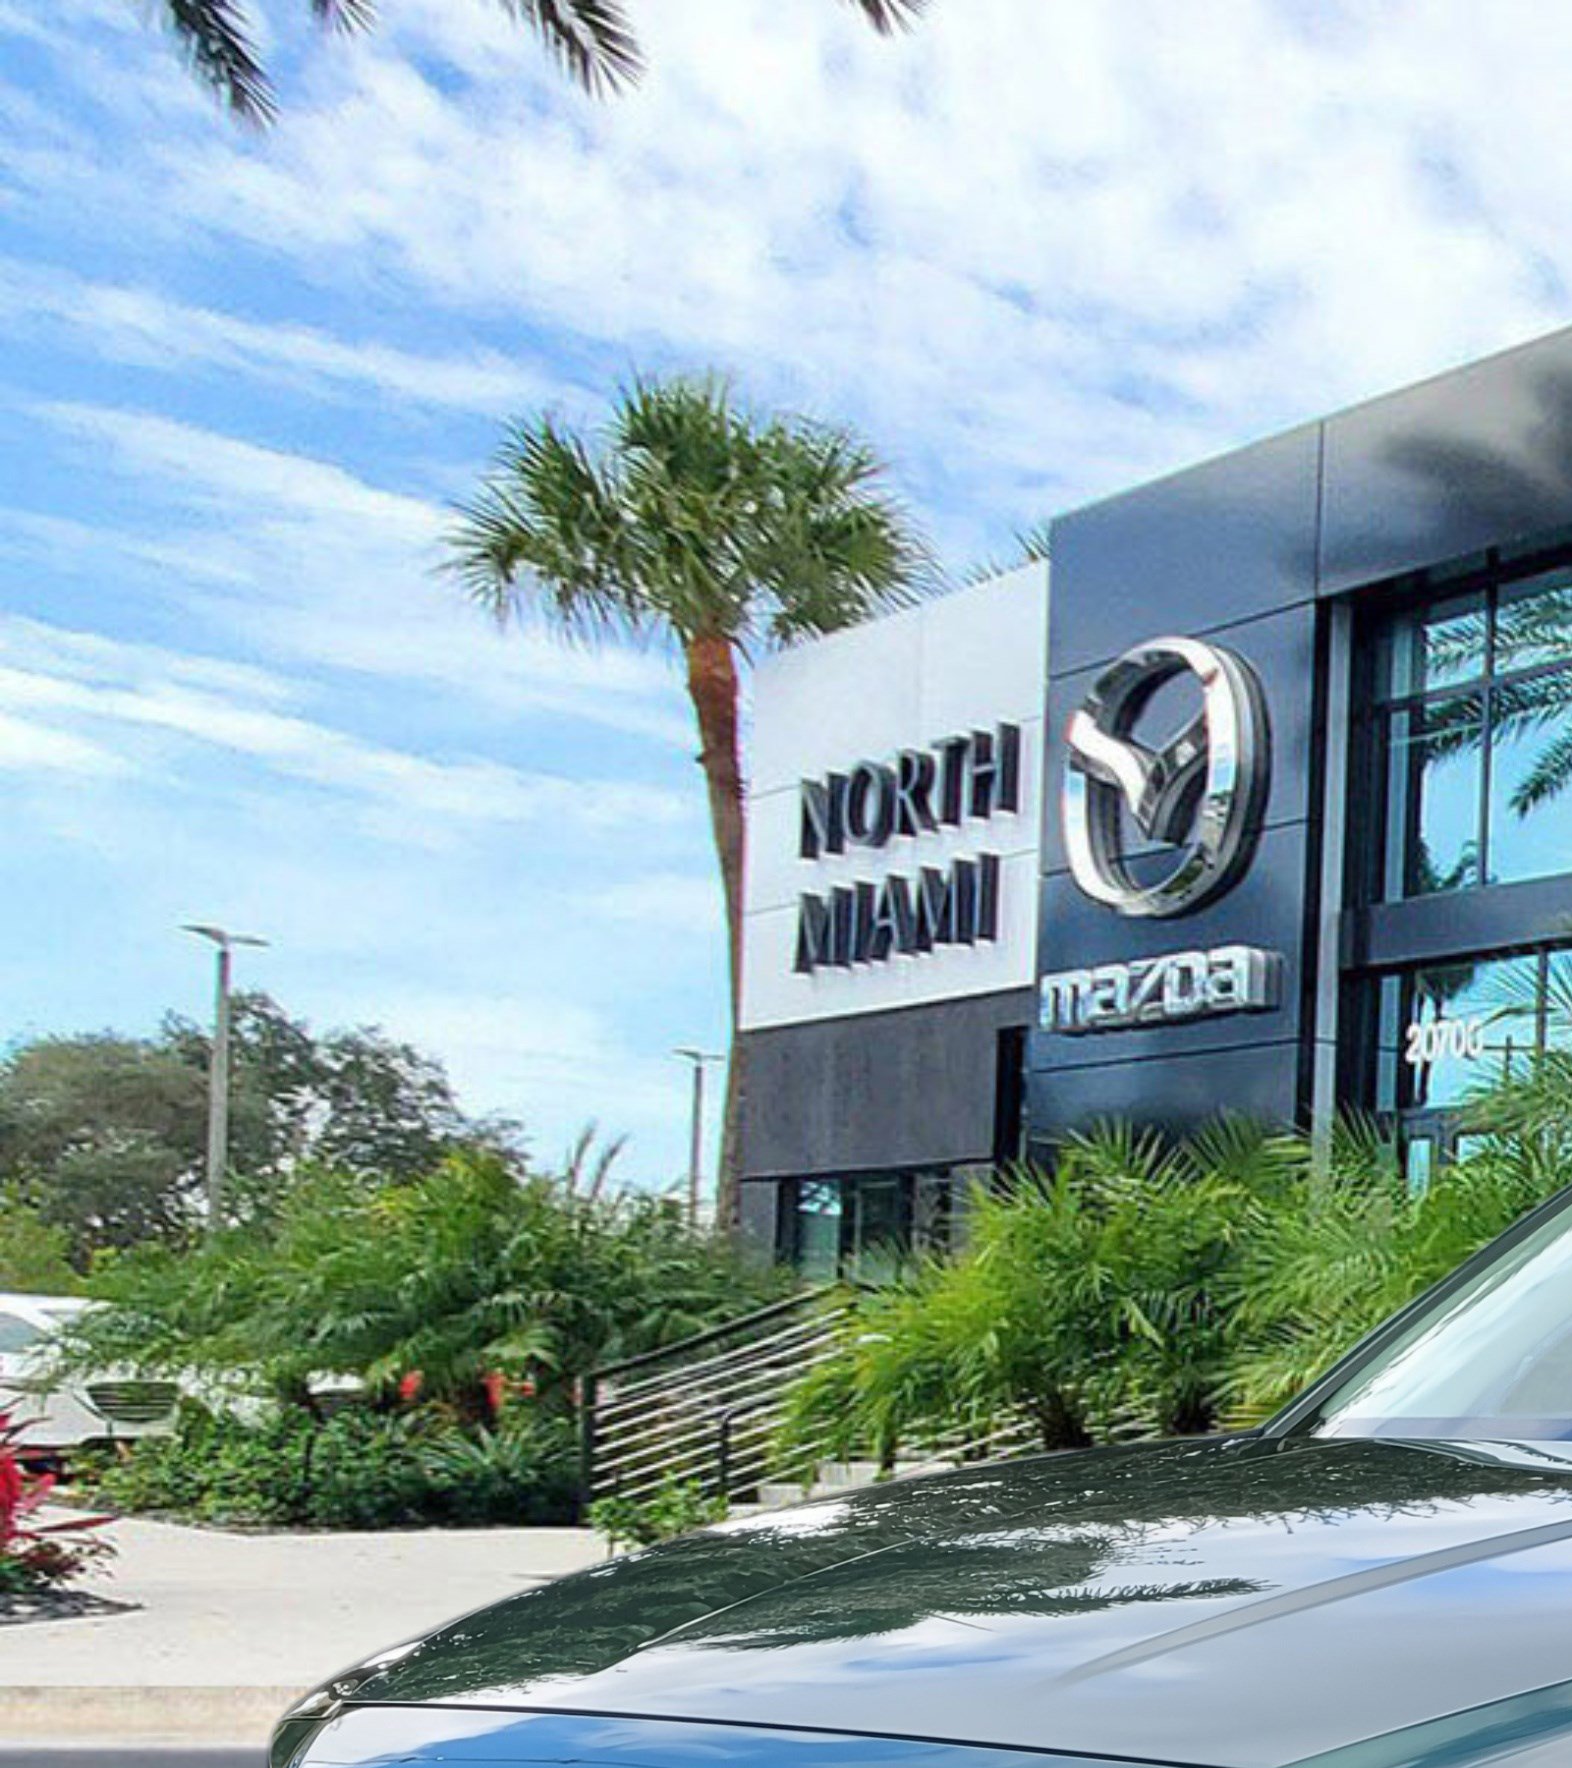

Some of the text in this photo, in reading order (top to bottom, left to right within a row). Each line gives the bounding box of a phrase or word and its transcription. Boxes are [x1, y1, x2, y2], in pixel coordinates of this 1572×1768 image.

[799, 720, 1020, 861] NORTH
[794, 852, 1000, 974] MIAMI
[1039, 945, 1272, 1032] mazda
